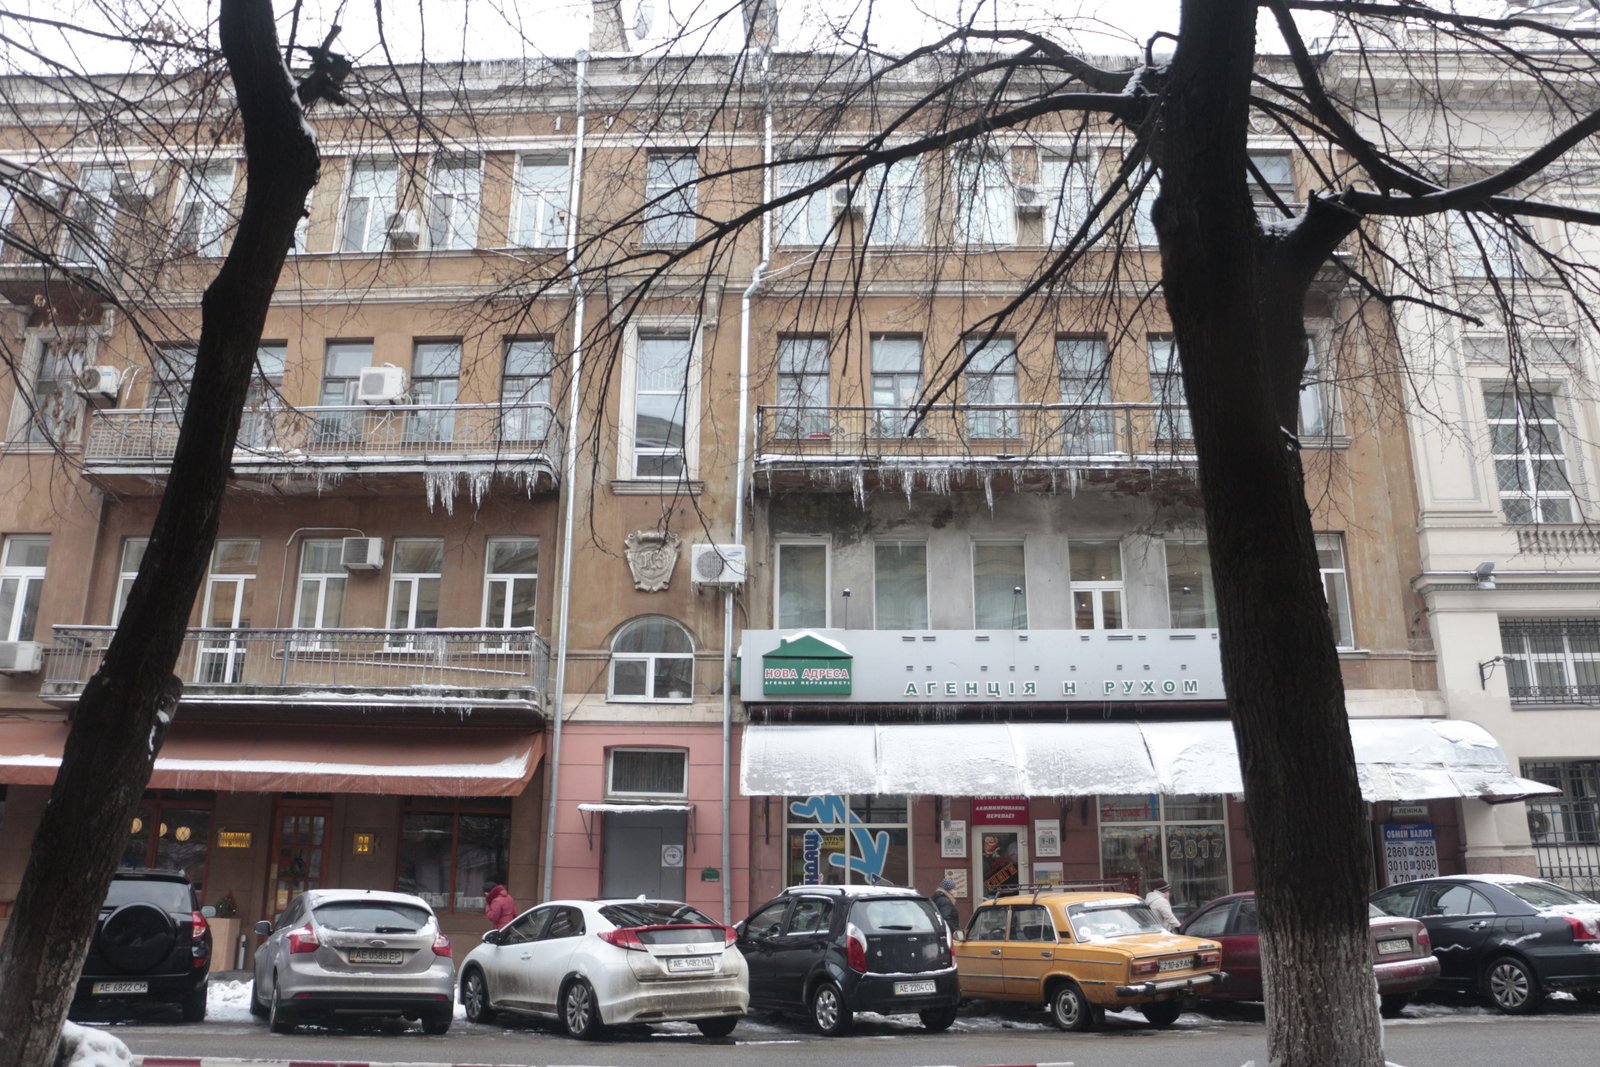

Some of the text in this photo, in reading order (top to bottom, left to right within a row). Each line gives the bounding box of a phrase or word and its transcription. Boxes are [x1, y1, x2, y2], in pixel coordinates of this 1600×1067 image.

[764, 668, 849, 680] НОВА АДРЕСА
[904, 680, 1037, 698] АГЕНЦІЯ
[1103, 679, 1199, 695] РУХОМ
[1386, 829, 1433, 839] ОБМЕН ВАЛЮТ
[1169, 838, 1224, 859] 2017
[1386, 846, 1408, 858] 2860
[1414, 845, 1435, 857] 2920
[1388, 860, 1409, 871] 3010
[1416, 859, 1437, 870] 3090
